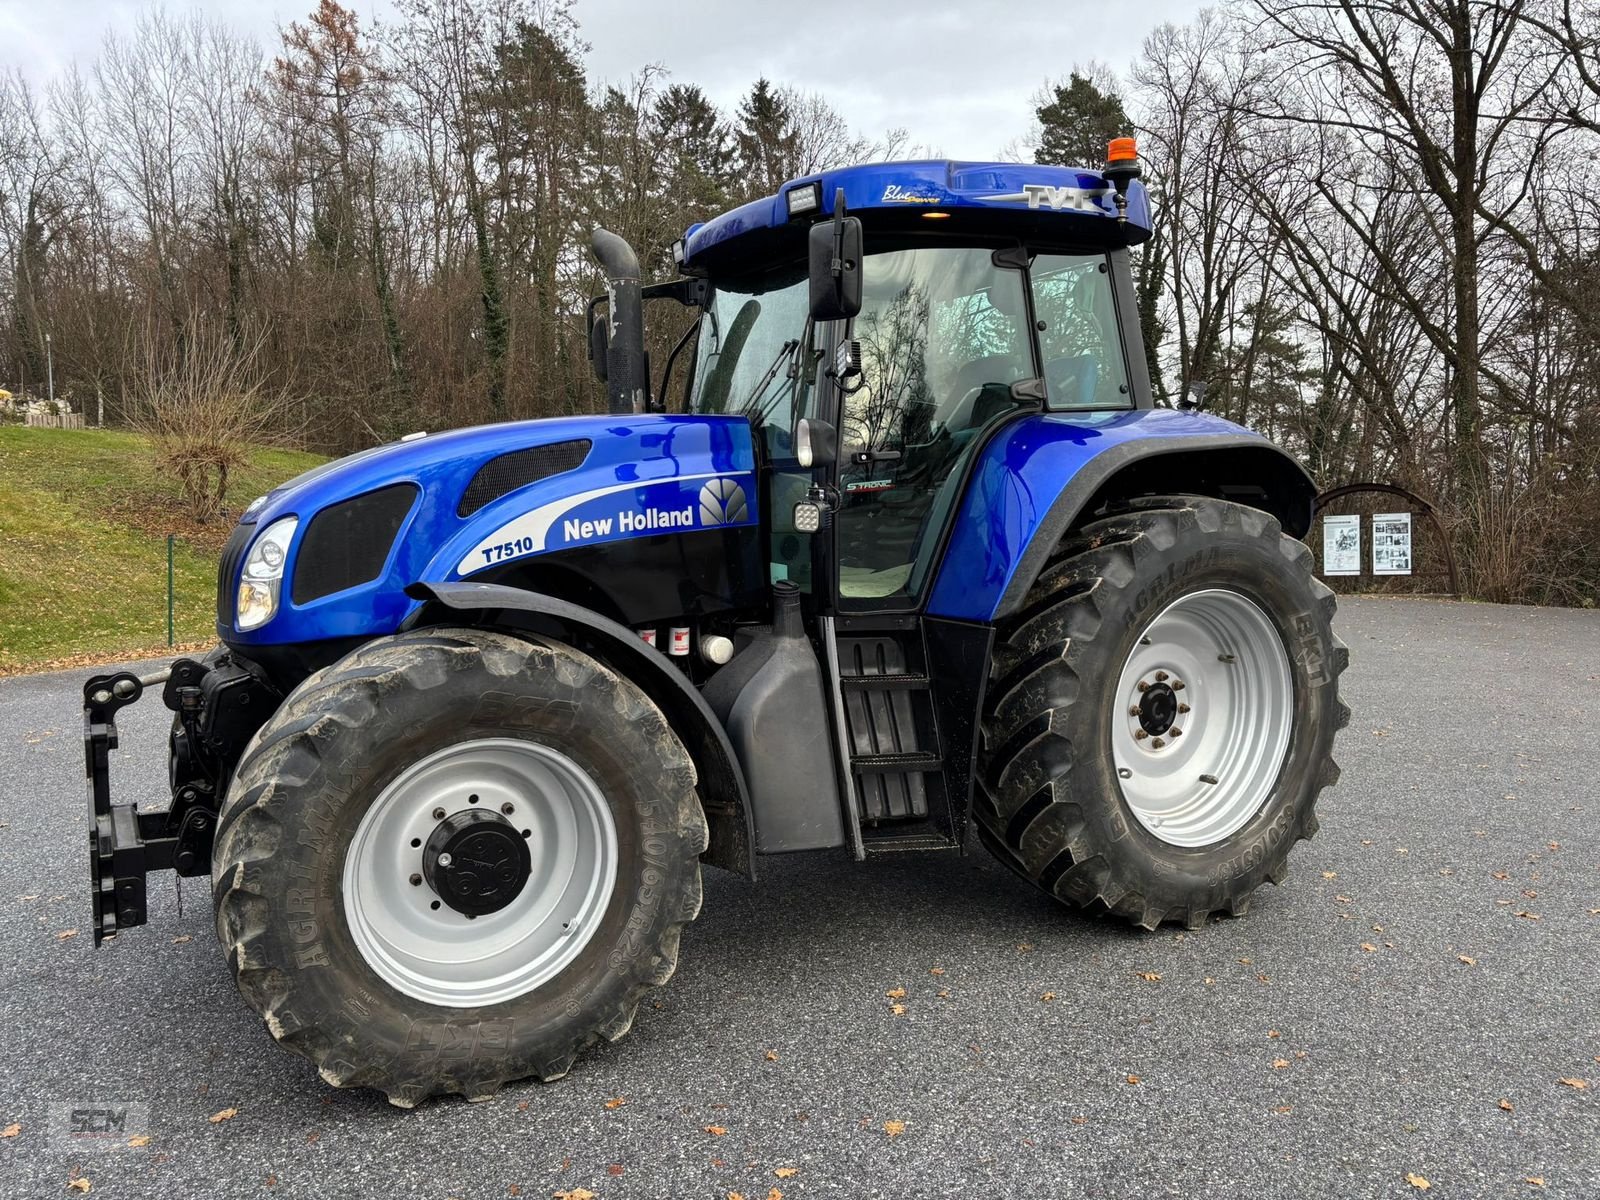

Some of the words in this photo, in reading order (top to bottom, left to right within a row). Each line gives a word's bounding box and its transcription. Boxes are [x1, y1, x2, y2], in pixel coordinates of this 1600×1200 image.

[882, 185, 912, 200] Blue
[1022, 184, 1090, 211] TVT
[563, 516, 612, 543] New
[618, 506, 693, 533] Holland
[481, 536, 534, 564] T7510
[1288, 609, 1330, 690] BKT
